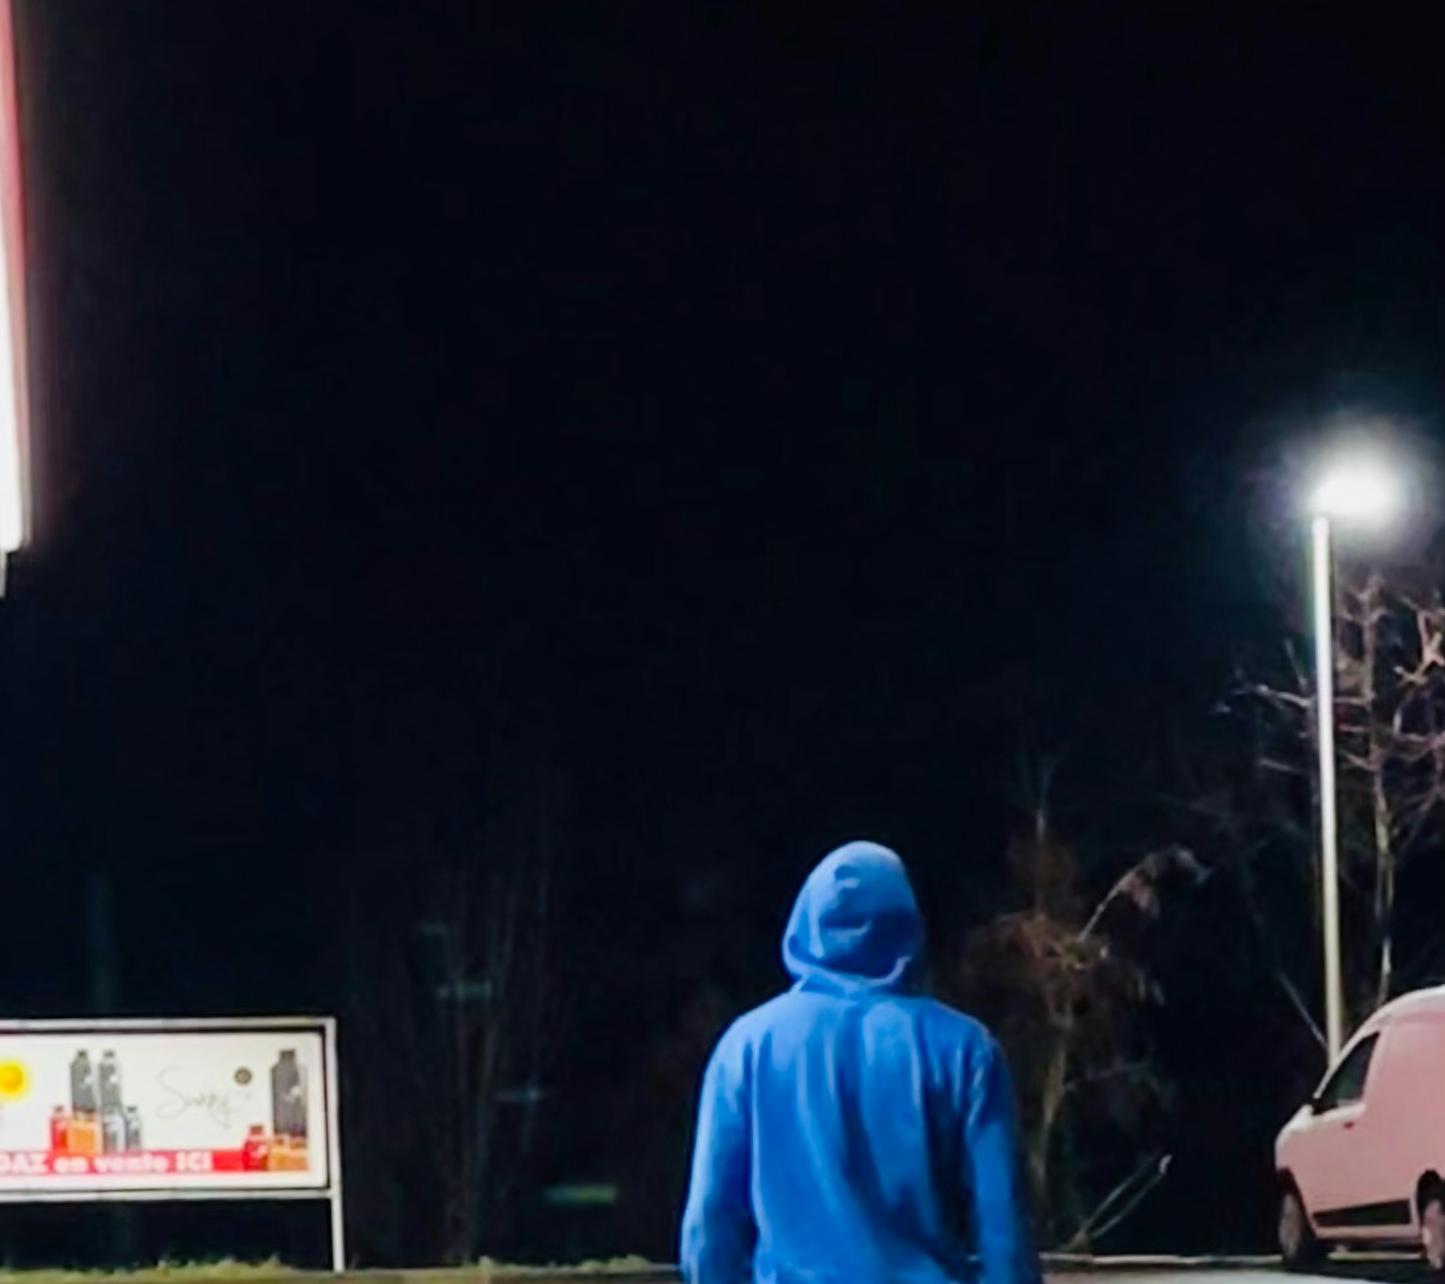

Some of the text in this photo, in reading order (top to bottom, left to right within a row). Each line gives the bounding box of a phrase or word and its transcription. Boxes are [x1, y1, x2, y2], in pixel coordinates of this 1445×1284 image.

[55, 1155, 90, 1174] en
[94, 1153, 169, 1174] vente
[175, 1151, 213, 1173] ICI
